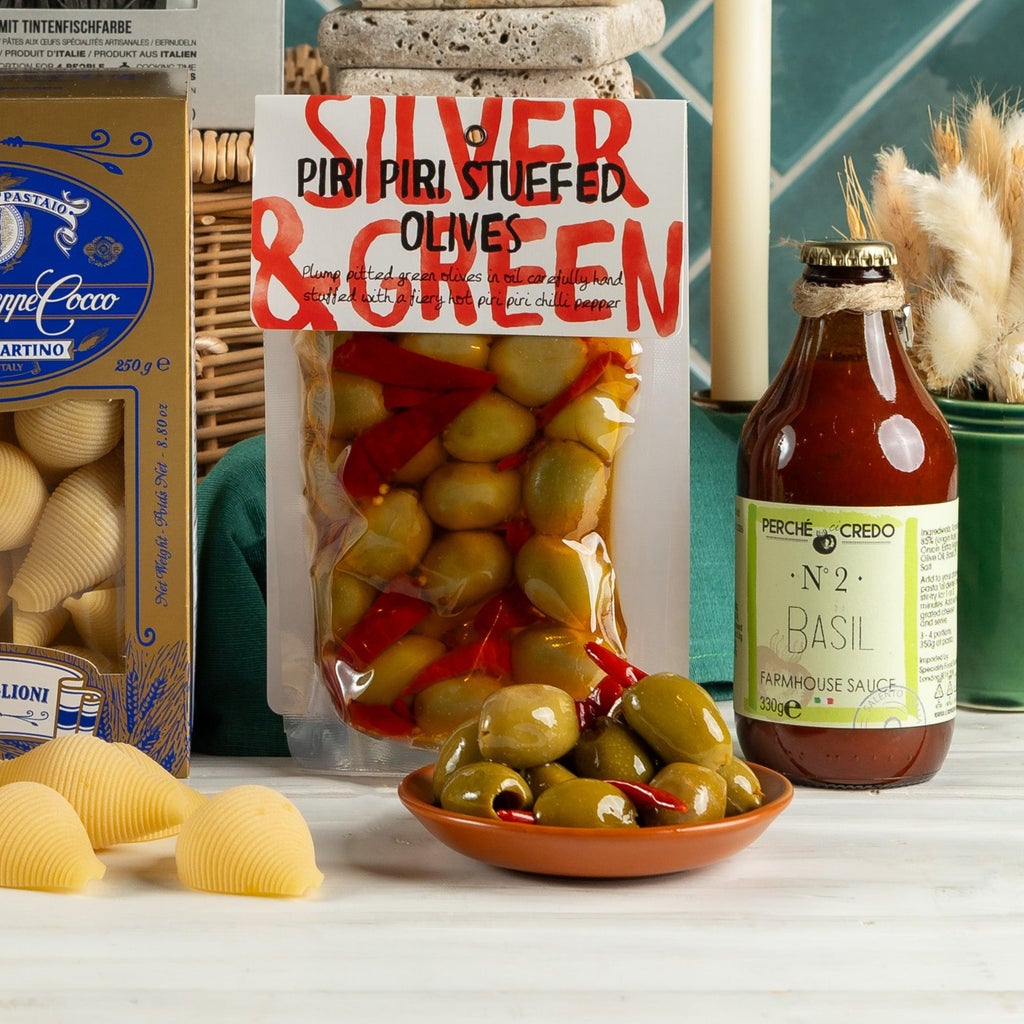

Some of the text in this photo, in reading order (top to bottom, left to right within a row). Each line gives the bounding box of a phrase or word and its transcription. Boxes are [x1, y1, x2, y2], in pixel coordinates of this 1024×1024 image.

[22, 20, 132, 34] TINTENFISCHFARBE
[4, 50, 45, 58] PRODUIT
[93, 50, 137, 58] PRODUKT
[139, 50, 158, 58] AUS
[160, 51, 197, 59] ITALIEN
[297, 157, 626, 203] PIRI PIRI STUFFED
[4, 191, 67, 215] PASTAIO
[400, 210, 522, 254] OLIVES
[302, 263, 624, 291] Plump pitted green olives in oil carefully hand
[348, 216, 684, 338] GREEN
[35, 269, 120, 336] Cocco
[303, 287, 622, 312] stuffed with a fiery hot piri piri chilli pepper
[154, 403, 173, 607] Net Weight Poids Net 8.80 oz
[762, 517, 813, 537] PERCHÉ
[839, 523, 895, 539] CREDO
[835, 566, 848, 593] 2
[760, 670, 896, 693] FARMHOUSE SAUCE
